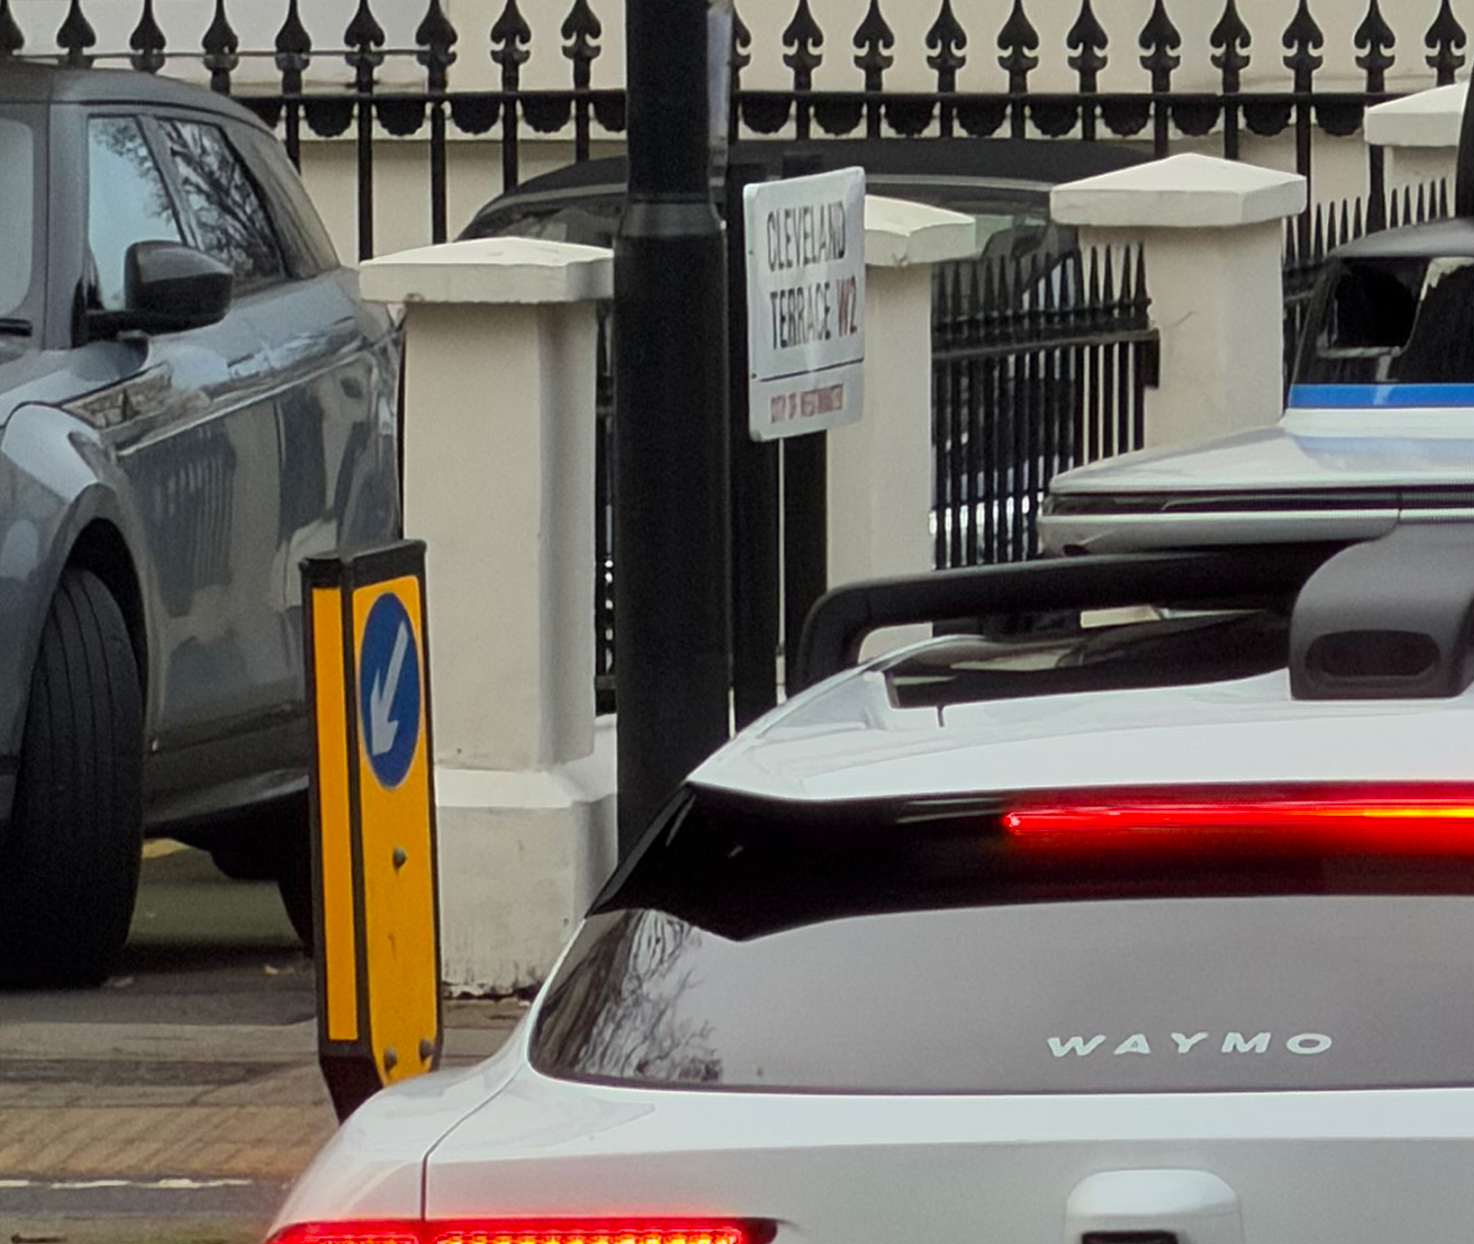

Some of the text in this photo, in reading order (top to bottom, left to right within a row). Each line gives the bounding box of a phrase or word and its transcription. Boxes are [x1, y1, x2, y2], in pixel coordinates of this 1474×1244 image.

[766, 200, 847, 273] CLEVELAND
[769, 275, 858, 350] TERRACE W2
[1047, 1032, 1333, 1058] WAYMO
